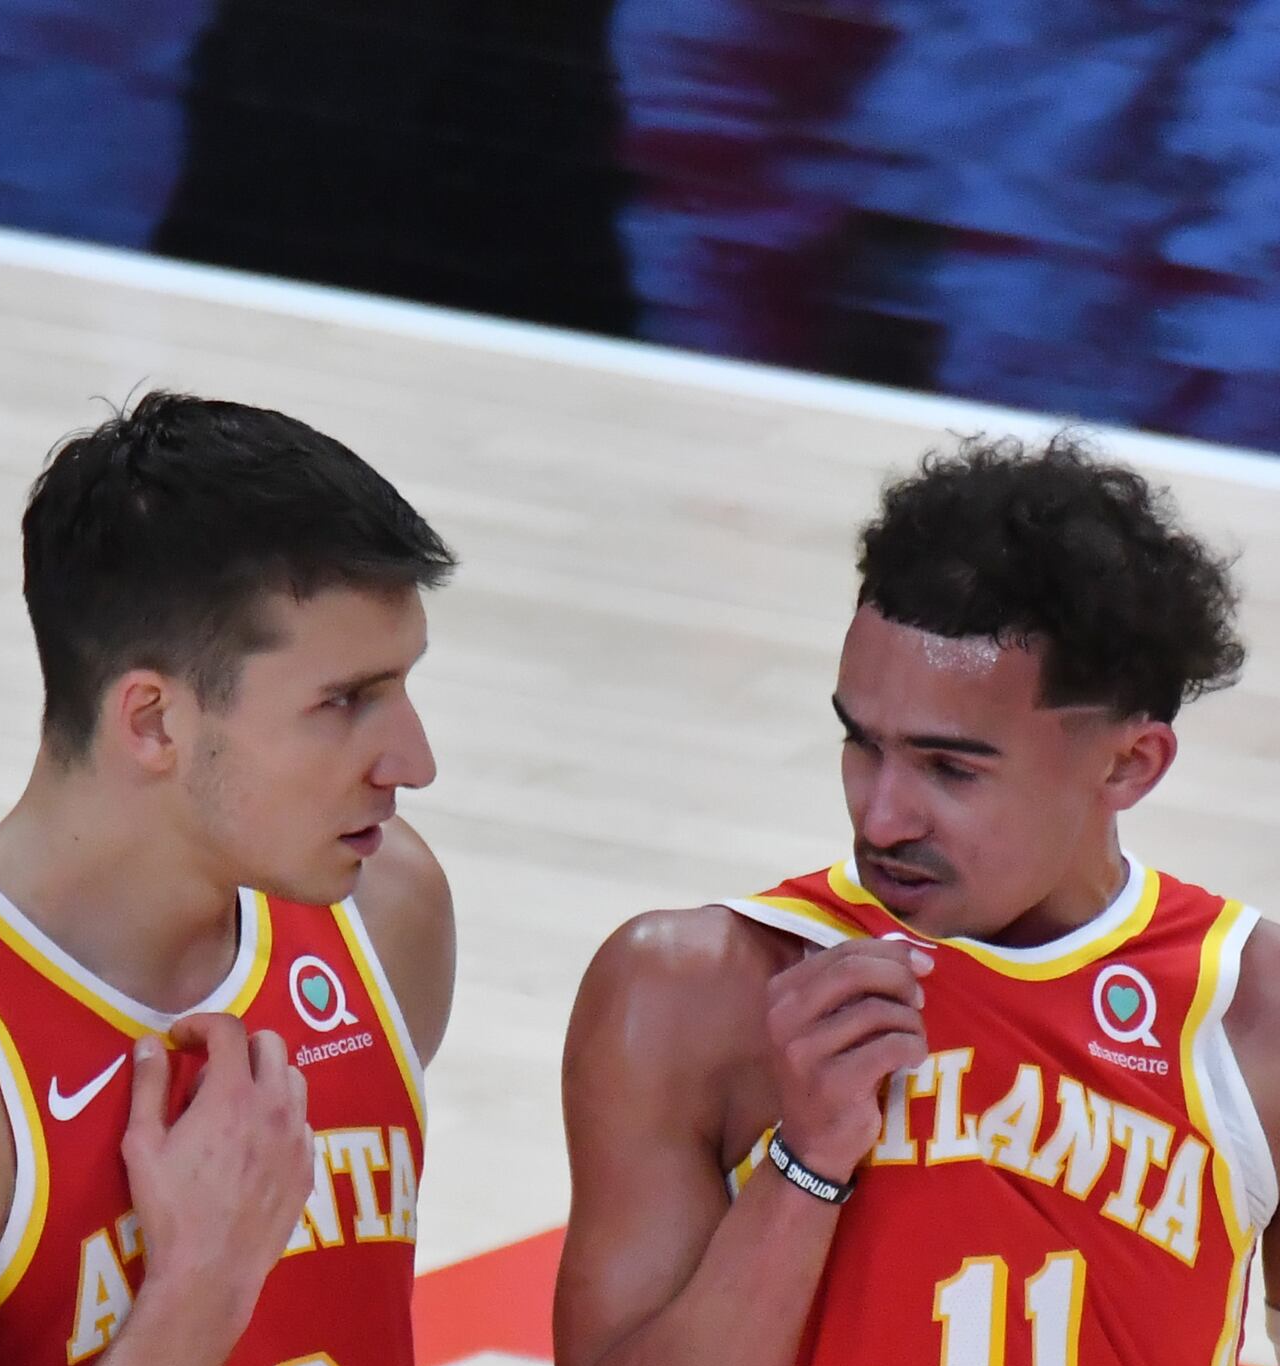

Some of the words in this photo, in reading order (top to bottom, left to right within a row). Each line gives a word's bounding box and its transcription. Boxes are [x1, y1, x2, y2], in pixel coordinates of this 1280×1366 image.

[296, 1032, 374, 1067] sharecare
[1088, 1041, 1169, 1076] sharecare
[769, 1139, 789, 1170] GIVE
[871, 1046, 1213, 1268] TLANTA
[787, 1163, 839, 1201] NOTHING
[66, 1126, 418, 1366] ANTA
